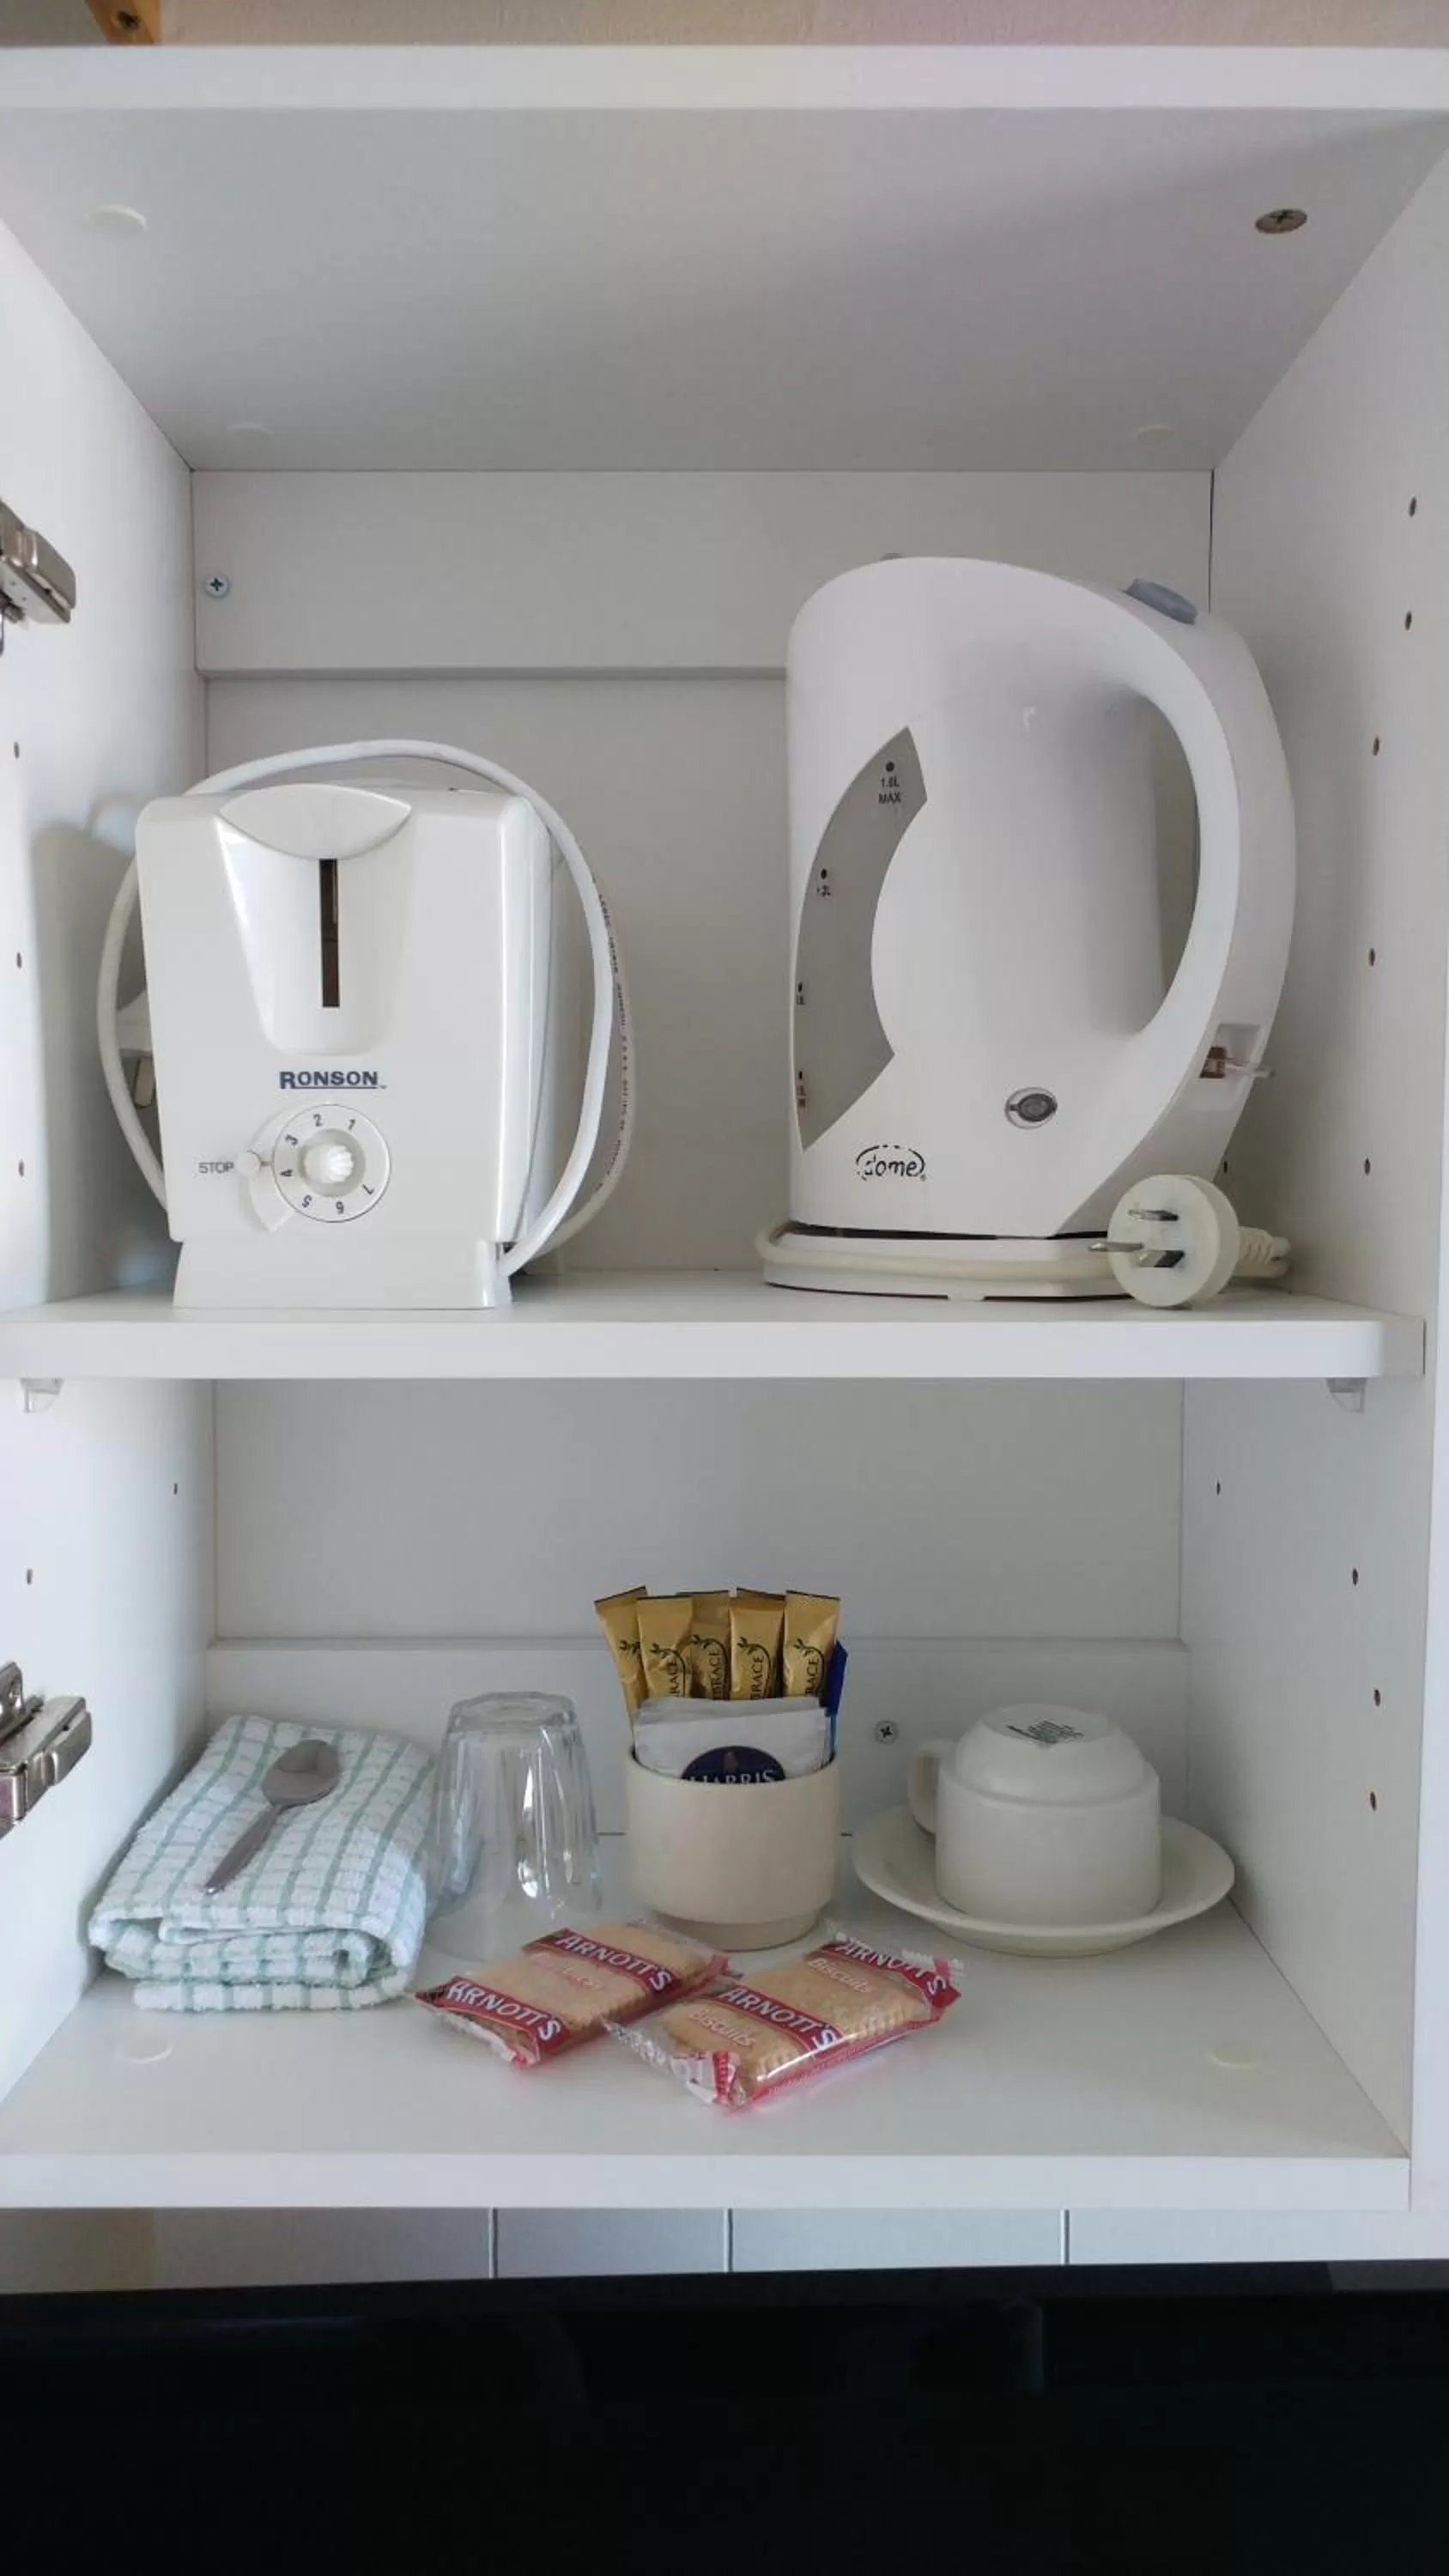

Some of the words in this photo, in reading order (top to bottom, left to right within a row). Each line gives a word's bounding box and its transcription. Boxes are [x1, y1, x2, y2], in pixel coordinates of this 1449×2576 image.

[878, 792, 901, 805] MAX
[280, 1071, 378, 1089] RONSON
[312, 1114, 323, 1127] 2
[347, 1119, 355, 1130] 1
[285, 1134, 298, 1145] 3
[198, 1162, 233, 1174] STOP
[301, 1194, 312, 1207] 5
[336, 1200, 344, 1214] 6
[555, 1935, 672, 1991] ARNOTT'S
[807, 1957, 875, 1993] Biscuits
[446, 1981, 561, 2041] ARNOTT'S
[718, 1987, 839, 2050] ARNOTT'S
[689, 2008, 756, 2047] Biscuits
